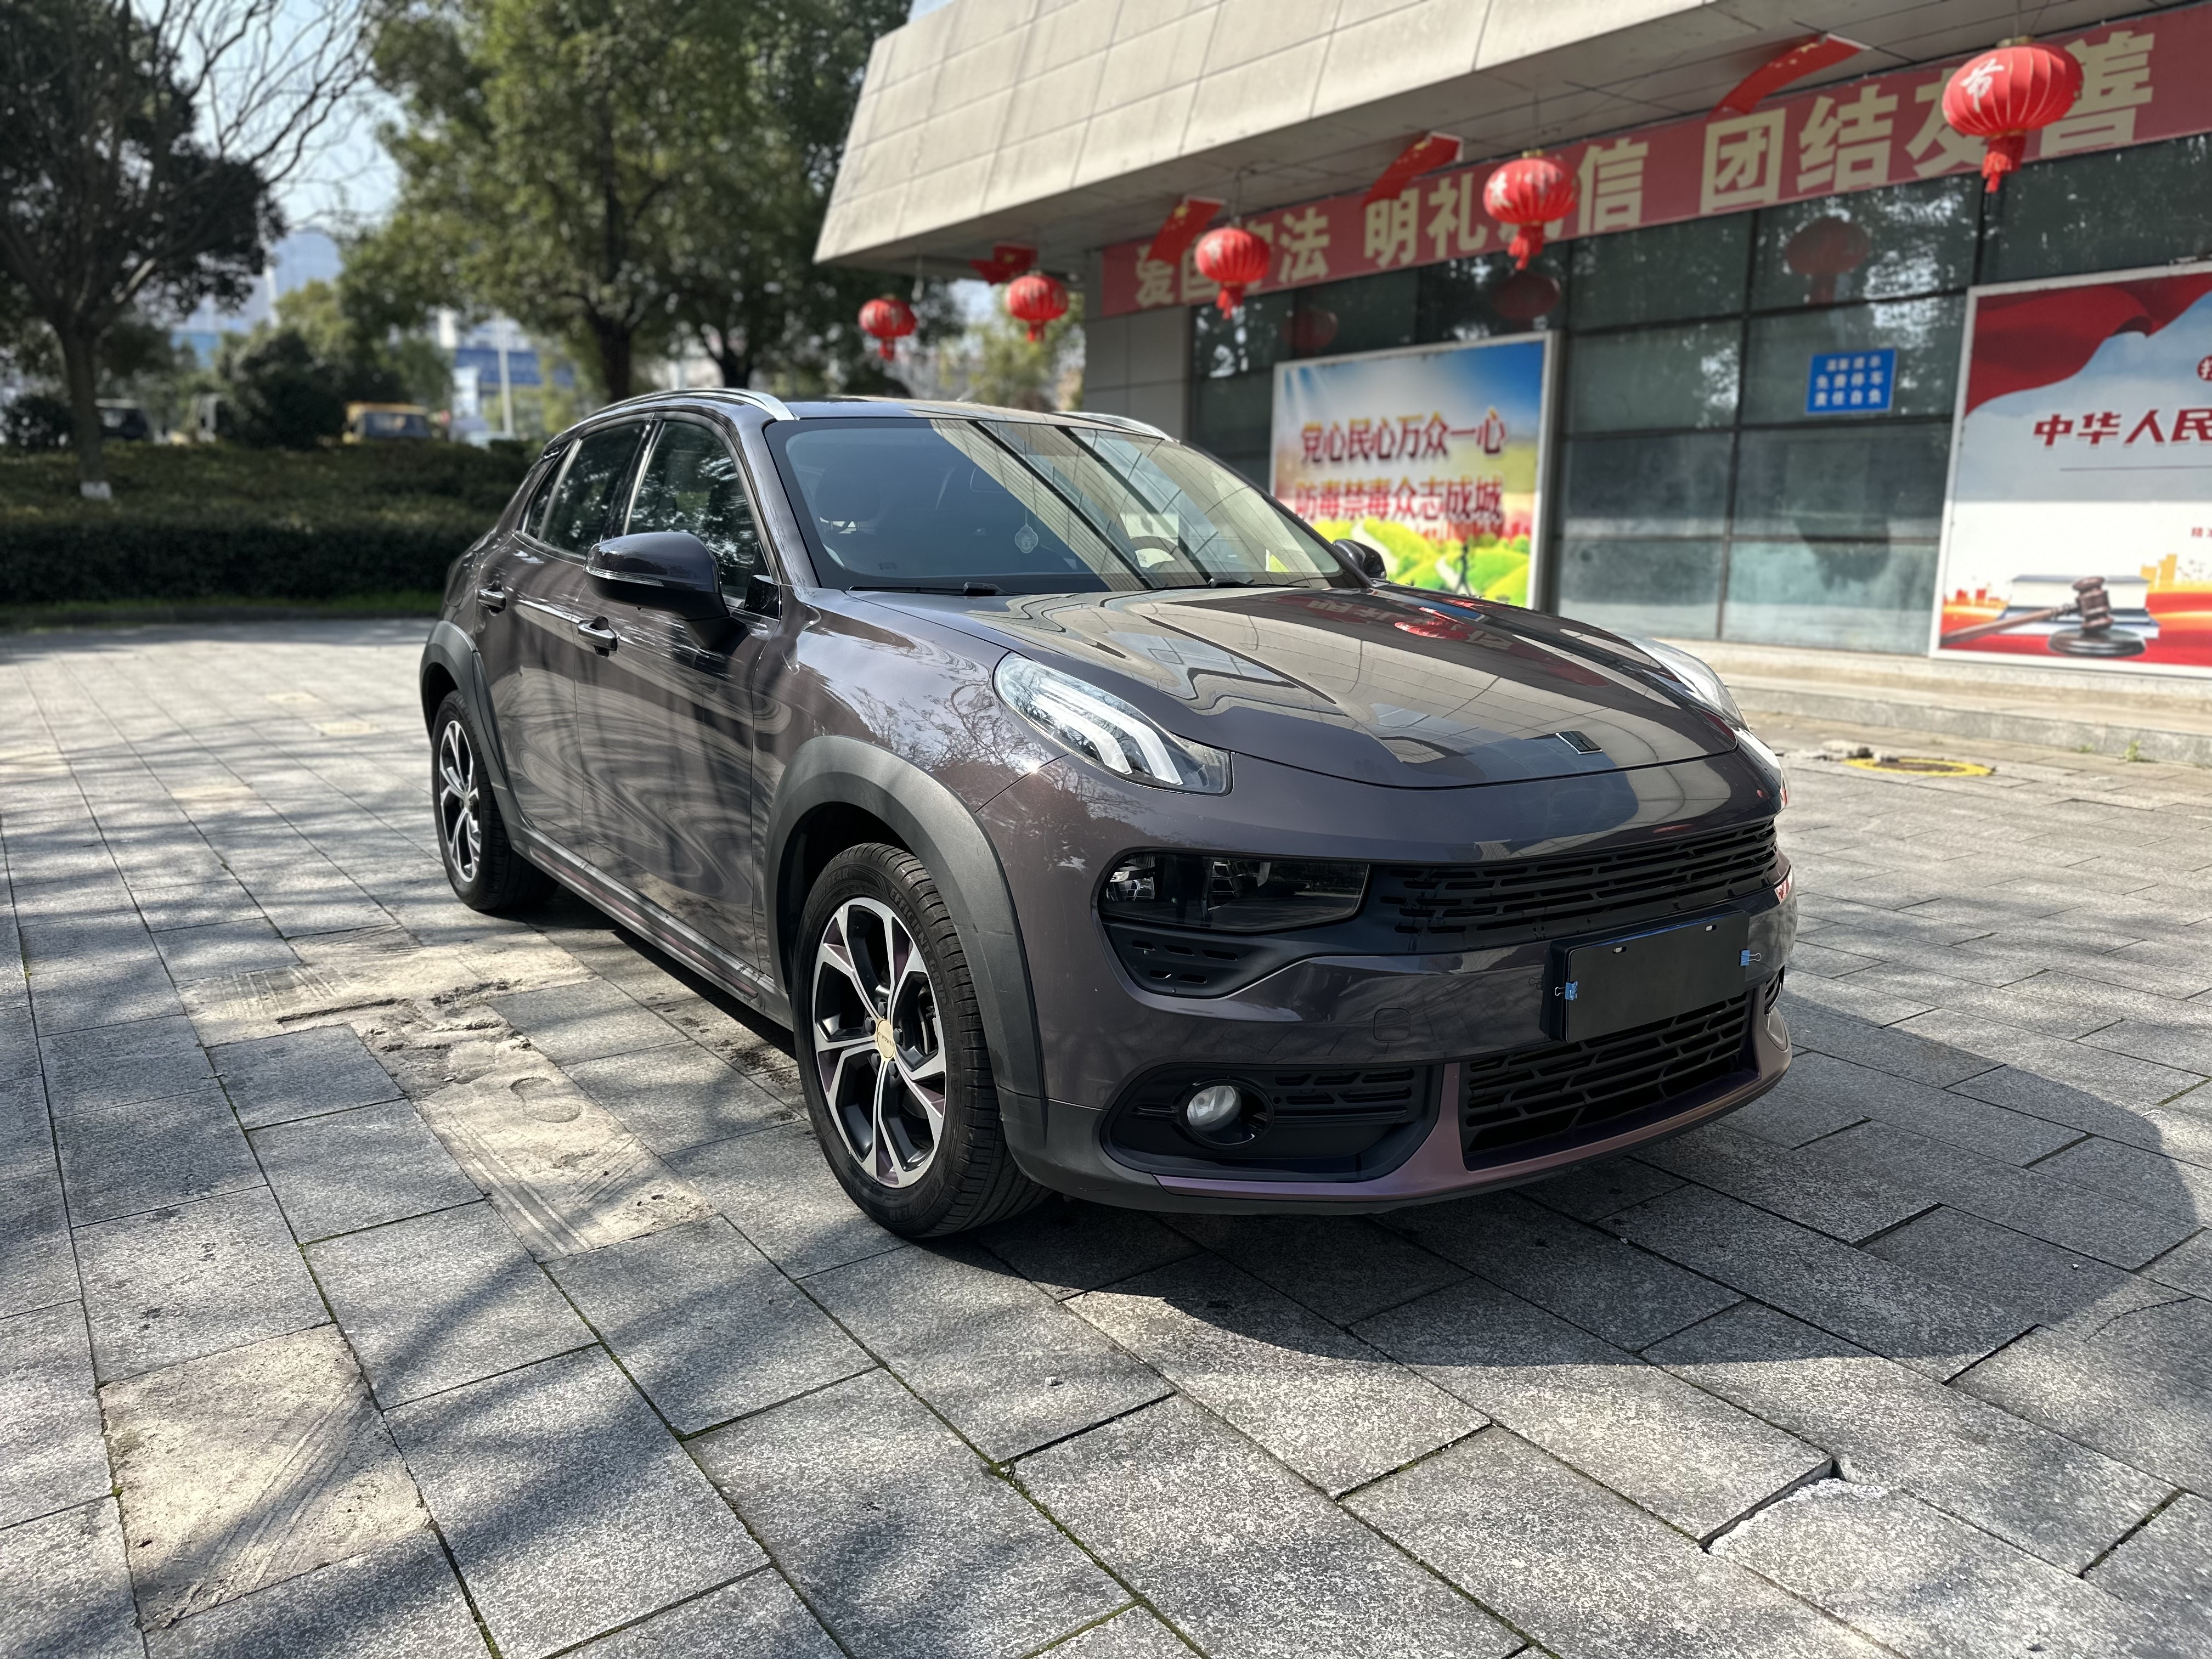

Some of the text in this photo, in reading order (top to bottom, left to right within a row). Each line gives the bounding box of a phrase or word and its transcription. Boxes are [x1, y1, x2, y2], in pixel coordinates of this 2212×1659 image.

[1363, 137, 1648, 268] 明礼信
[1300, 407, 1505, 464] 党心民心万众一心
[2033, 408, 2212, 447] 中华人民
[889, 887, 932, 954] EFFICIENT
[928, 959, 948, 1006] GRIP
